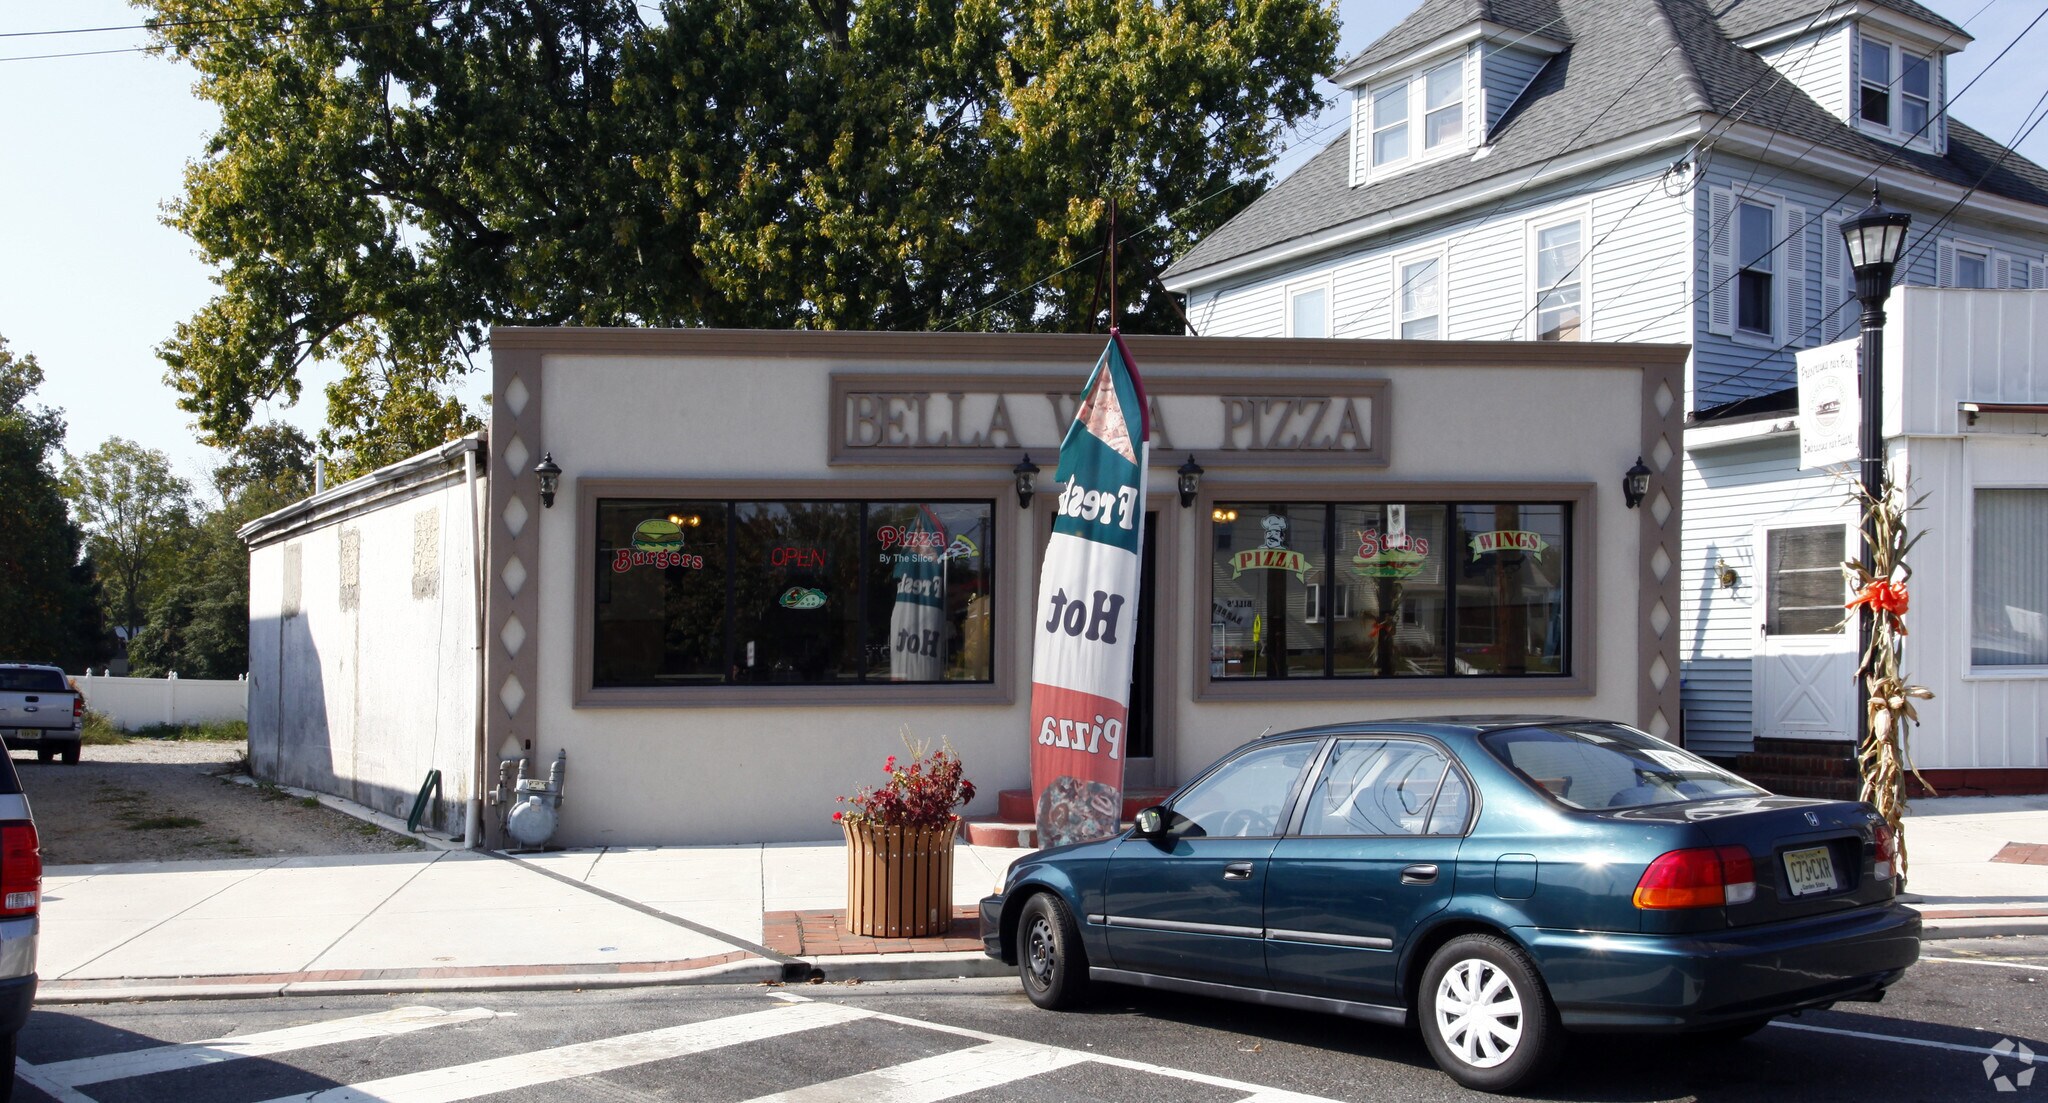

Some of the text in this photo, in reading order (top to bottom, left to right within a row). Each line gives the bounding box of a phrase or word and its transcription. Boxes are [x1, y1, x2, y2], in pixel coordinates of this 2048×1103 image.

[846, 392, 1372, 451] BELLA VA PIZZA
[877, 525, 946, 551] Pizza
[1358, 528, 1429, 559] Subs
[1478, 533, 1539, 551] WINGS
[612, 549, 704, 573] Burgers
[770, 547, 827, 568] OPEN
[880, 553, 934, 565] By The Slice
[1240, 551, 1300, 572] PIZZA
